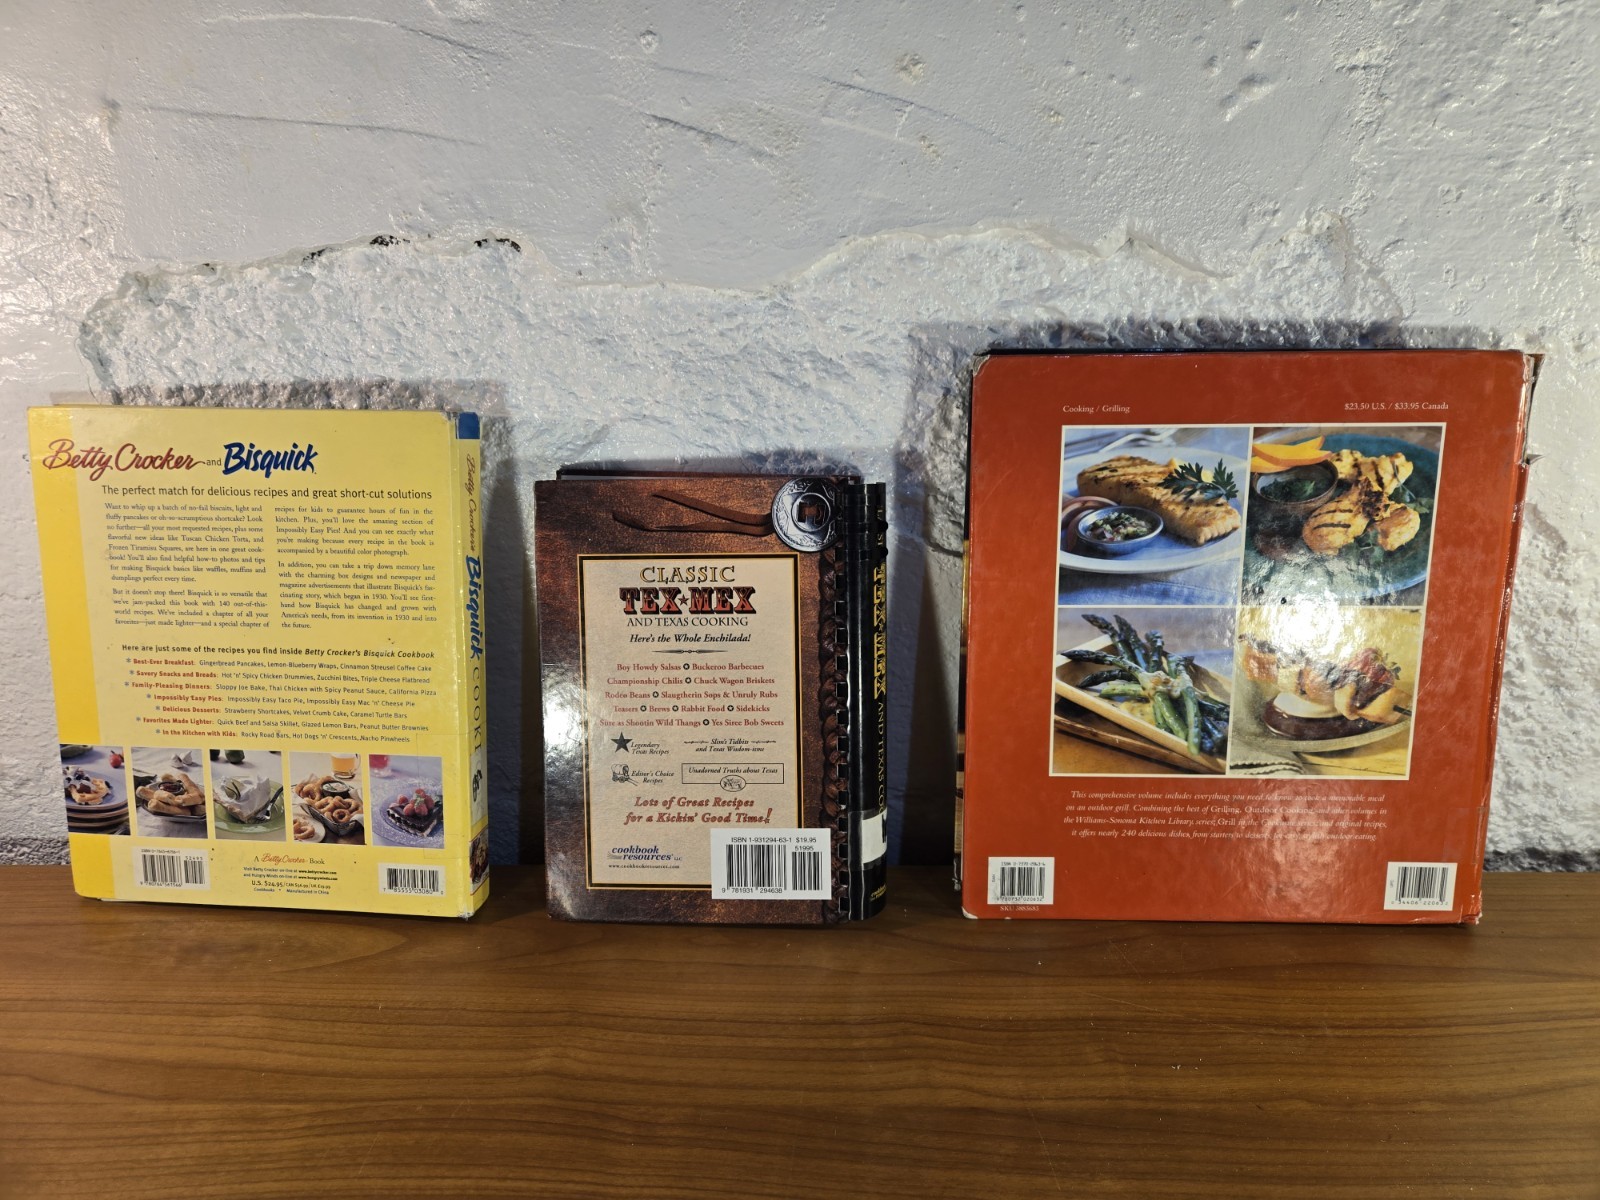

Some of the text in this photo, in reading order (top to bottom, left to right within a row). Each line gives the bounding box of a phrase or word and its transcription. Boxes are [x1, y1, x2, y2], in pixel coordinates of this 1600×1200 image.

[1062, 406, 1094, 414] Cooking
[1102, 405, 1130, 414] Grilling
[42, 438, 316, 481] Betty Crocker and Bisquick
[102, 485, 432, 500] The perfect match for delicious recipes and great short-cut solutions
[640, 566, 735, 585] CLASSIC
[466, 556, 485, 661] Bisquick
[627, 617, 748, 627] AND TEXAS COOKING
[630, 633, 751, 643] Here's the Whole Enchilada!
[155, 645, 170, 653] just
[305, 649, 325, 657] Betty
[397, 650, 434, 658] Cookbook
[617, 664, 630, 672] Boy
[607, 678, 660, 686] Championship
[719, 677, 744, 686] Wagon
[661, 691, 702, 700] Slaugtherin
[704, 691, 721, 700] Sops
[732, 691, 757, 699] Unruly
[600, 719, 615, 727] Sure
[675, 719, 701, 728] Thangs
[635, 796, 755, 810] Lots of Great Recipes
[624, 812, 643, 826] for
[656, 812, 698, 823] Kickin'
[701, 812, 732, 823] Good
[735, 809, 772, 824] Time!
[612, 845, 659, 854] cookbook
